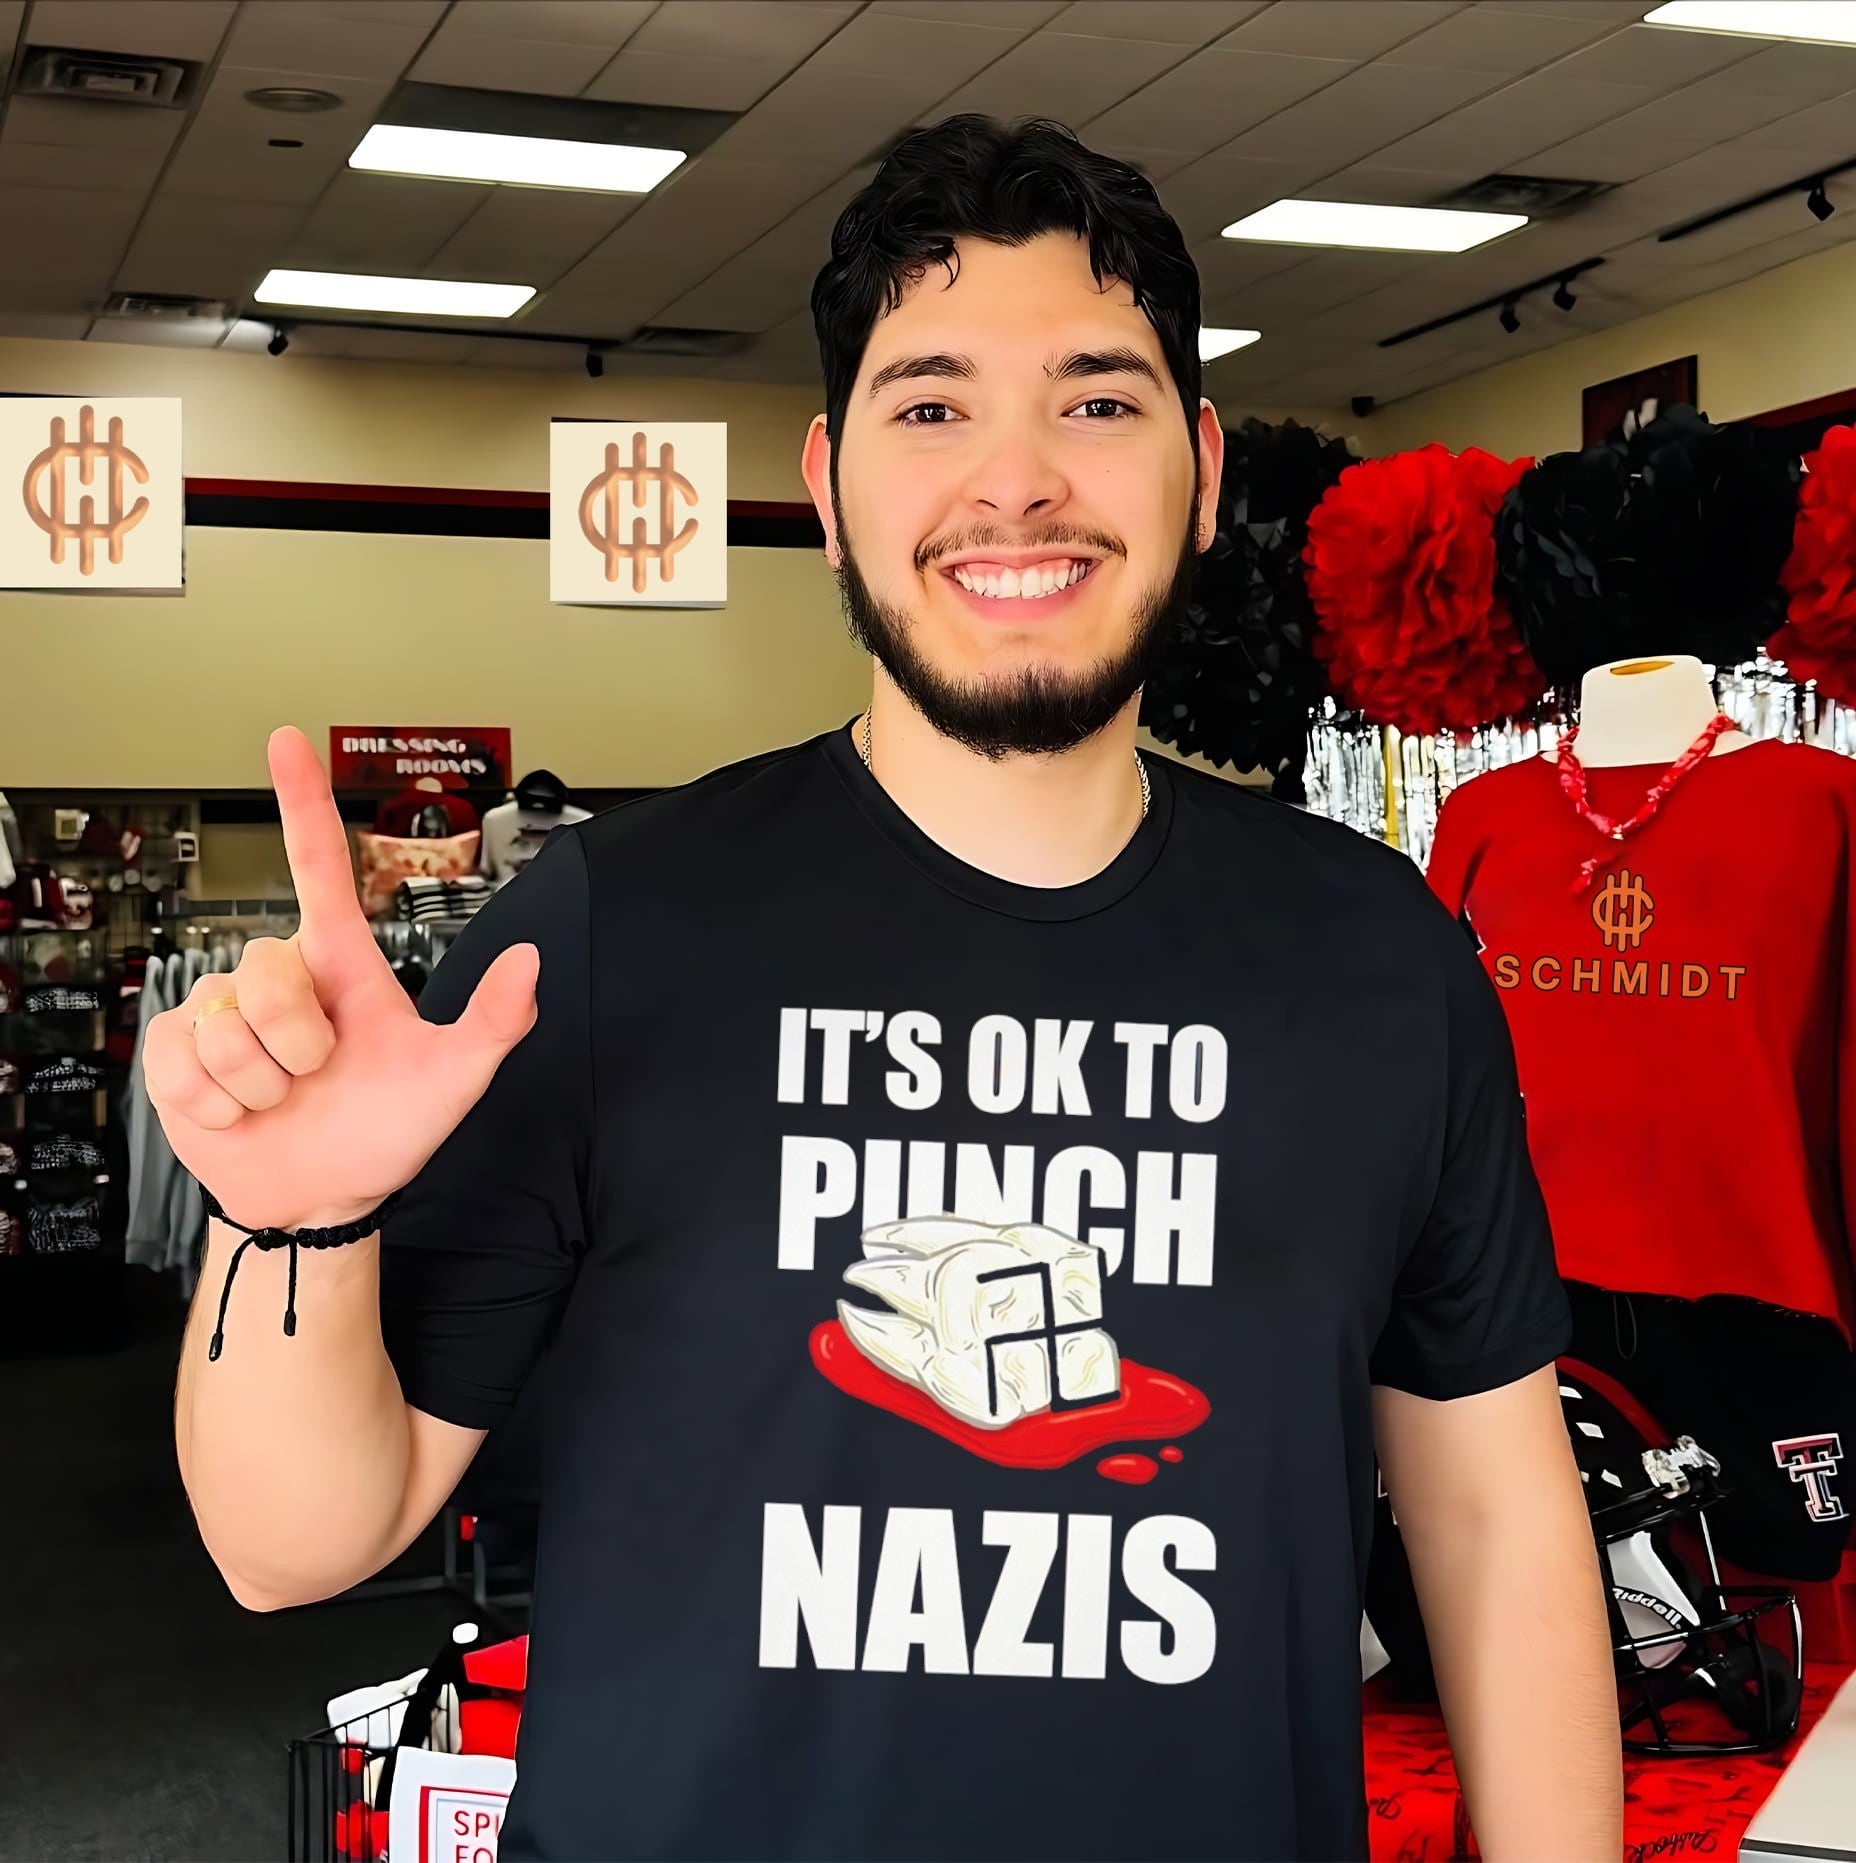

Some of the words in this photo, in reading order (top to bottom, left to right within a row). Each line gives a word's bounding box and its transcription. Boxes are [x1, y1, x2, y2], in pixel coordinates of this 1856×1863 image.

[342, 737, 467, 754] DRESSING
[396, 758, 487, 775] ROOMS
[1493, 953, 1748, 1000] SCHMIDT
[777, 1007, 942, 1111] IT'S
[967, 1014, 1094, 1116] OK
[1113, 1021, 1228, 1123] TO
[777, 1135, 1217, 1286] PUNCH
[758, 1502, 1217, 1684] NAZIS
